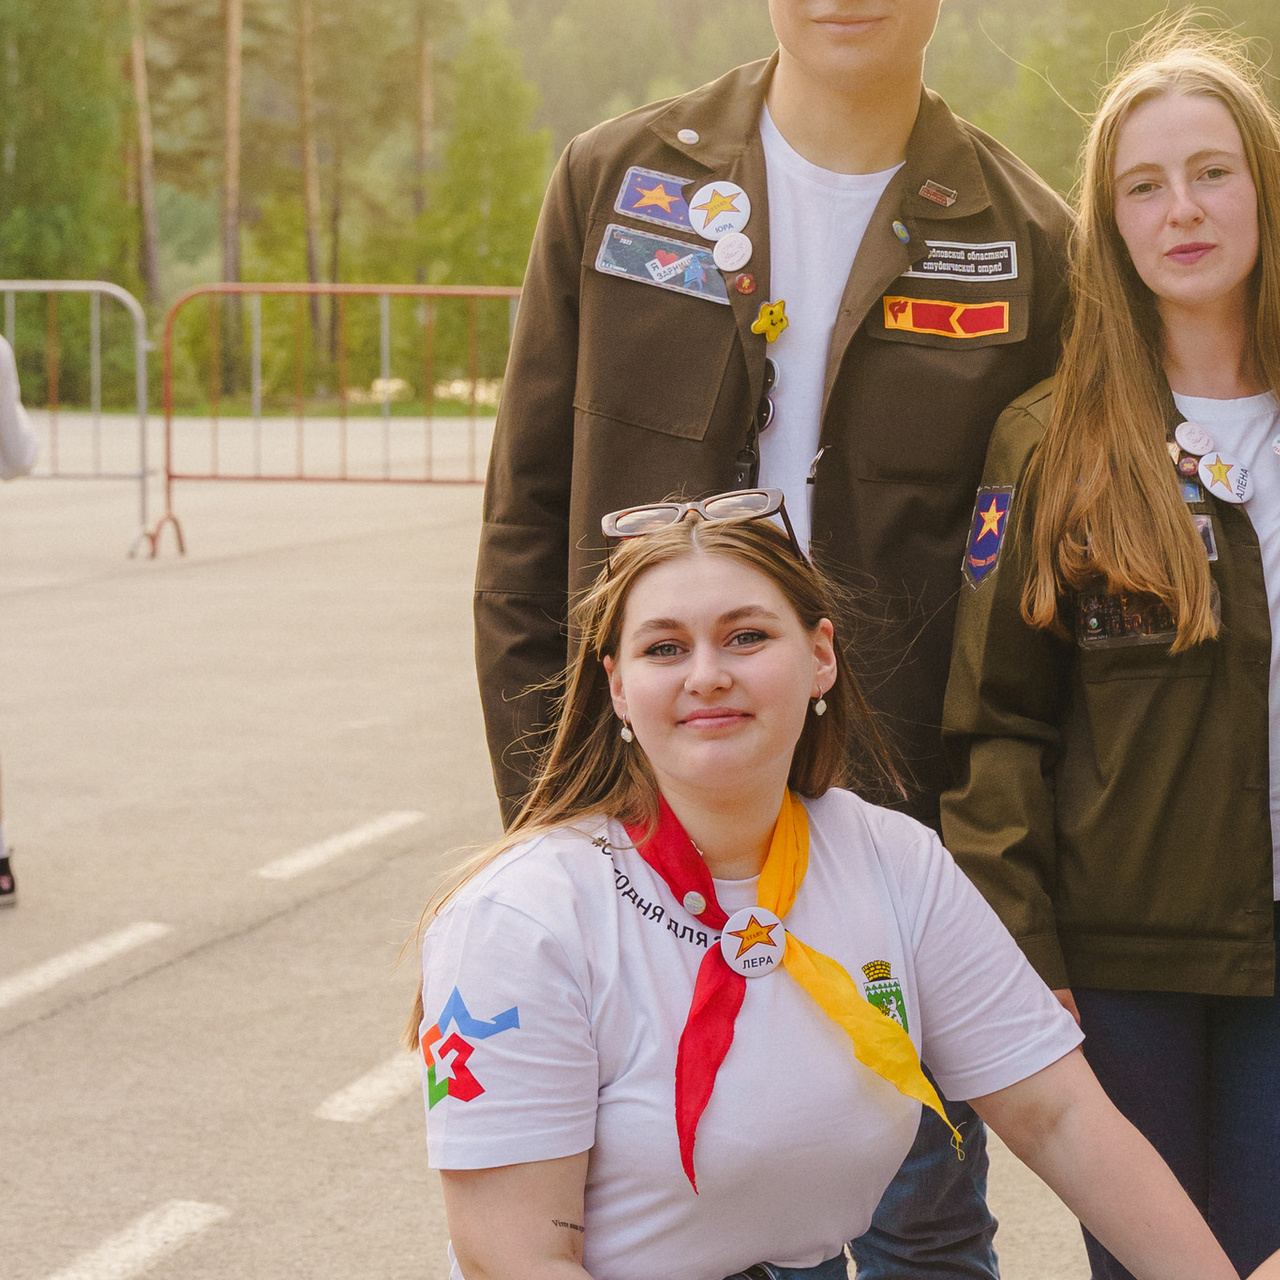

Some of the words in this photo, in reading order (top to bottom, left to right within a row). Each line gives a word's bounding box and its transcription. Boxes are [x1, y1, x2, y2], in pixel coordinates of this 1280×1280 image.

[715, 222, 734, 234] ЮРА
[650, 262, 660, 272] Я
[1236, 468, 1249, 500] АЛЁНА
[667, 917, 708, 948] ДЛЯ
[743, 955, 774, 969] ЛЕРА
